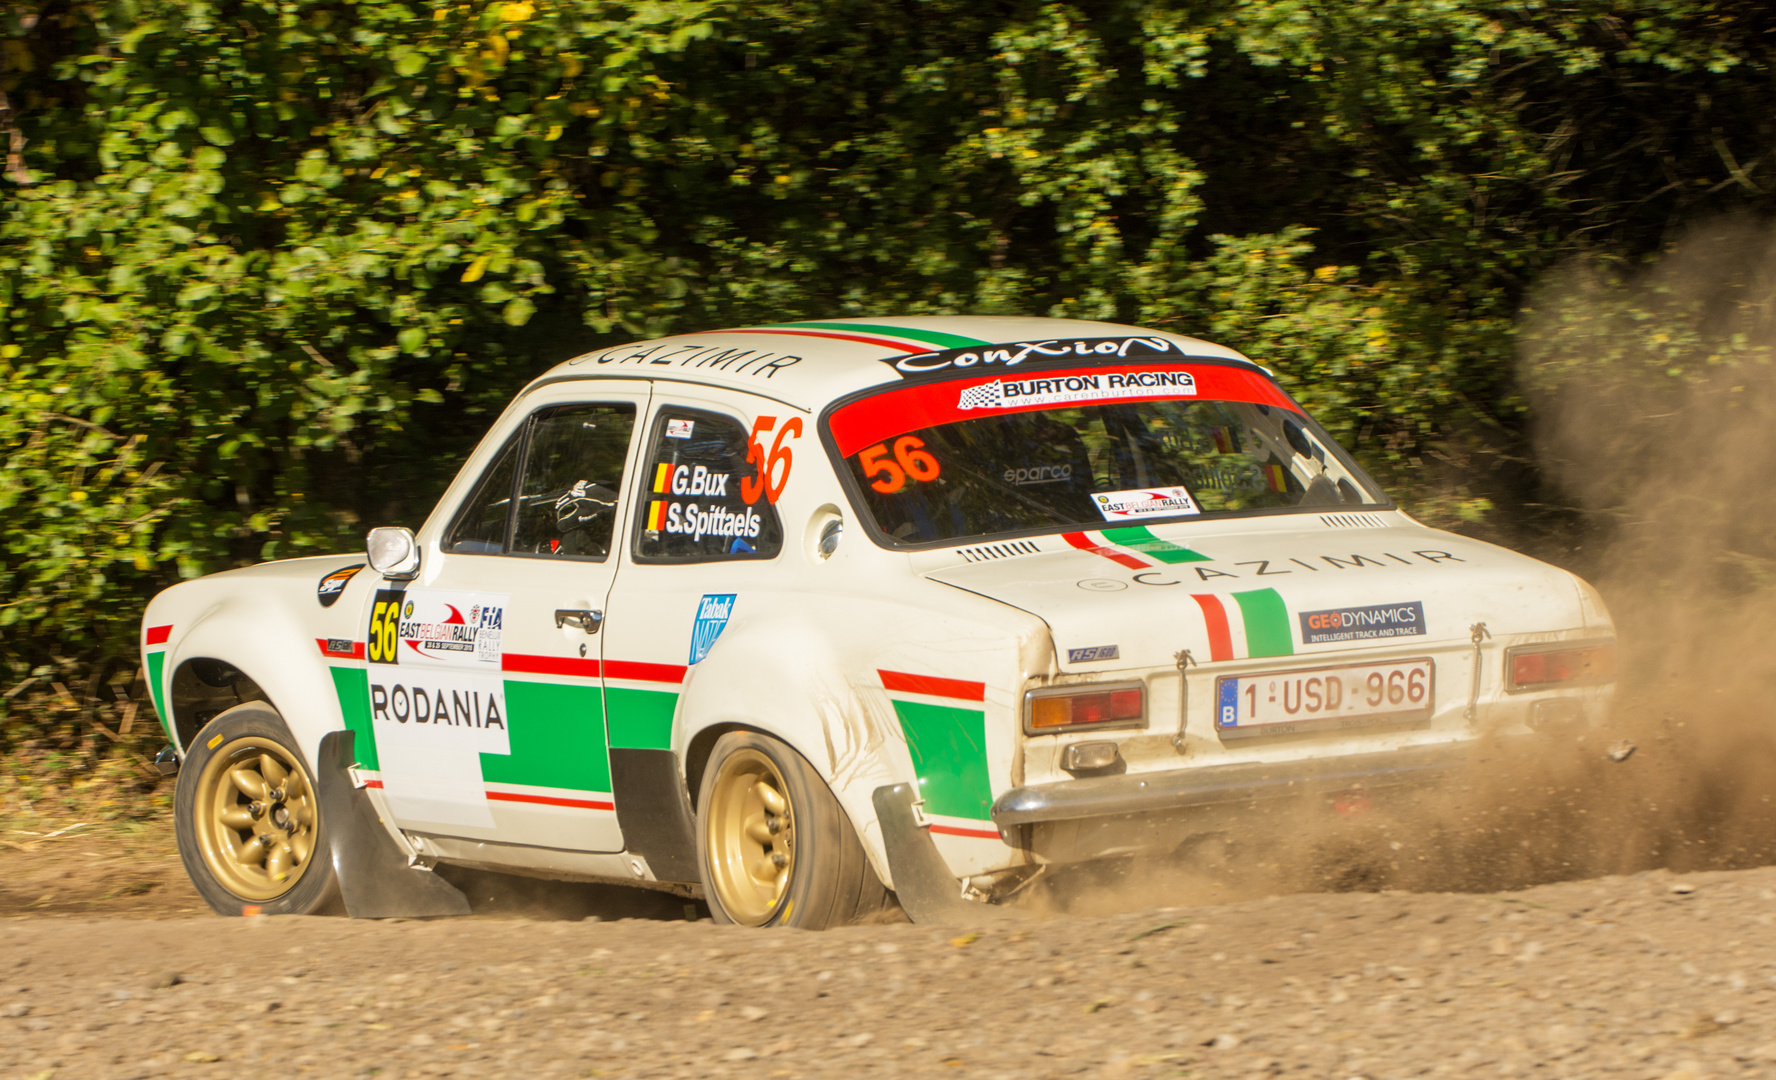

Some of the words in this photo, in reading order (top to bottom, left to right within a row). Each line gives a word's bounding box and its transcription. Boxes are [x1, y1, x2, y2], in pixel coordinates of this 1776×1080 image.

[597, 345, 803, 378] CAZIMIR
[1002, 375, 1099, 398] BURTON
[1108, 372, 1194, 391] RACING
[1008, 386, 1195, 407] www.carenburton.com
[741, 415, 803, 505] 56
[858, 435, 941, 494] 56
[1003, 464, 1072, 485] sparco
[671, 464, 730, 496] G.Bux
[665, 502, 761, 542] S.Spittaels
[1132, 550, 1468, 586] CAZIMIR
[699, 597, 732, 620] Tabak
[1308, 607, 1417, 629] GEODYNAMICS
[368, 601, 400, 662] 56
[1311, 631, 1353, 643] INTELLIGENT
[1355, 630, 1377, 639] TRACK
[1379, 628, 1394, 637] AND
[1395, 626, 1418, 636] TRACE
[478, 640, 501, 653] RALLY
[370, 684, 505, 730] RODANIA
[1222, 705, 1235, 723] B
